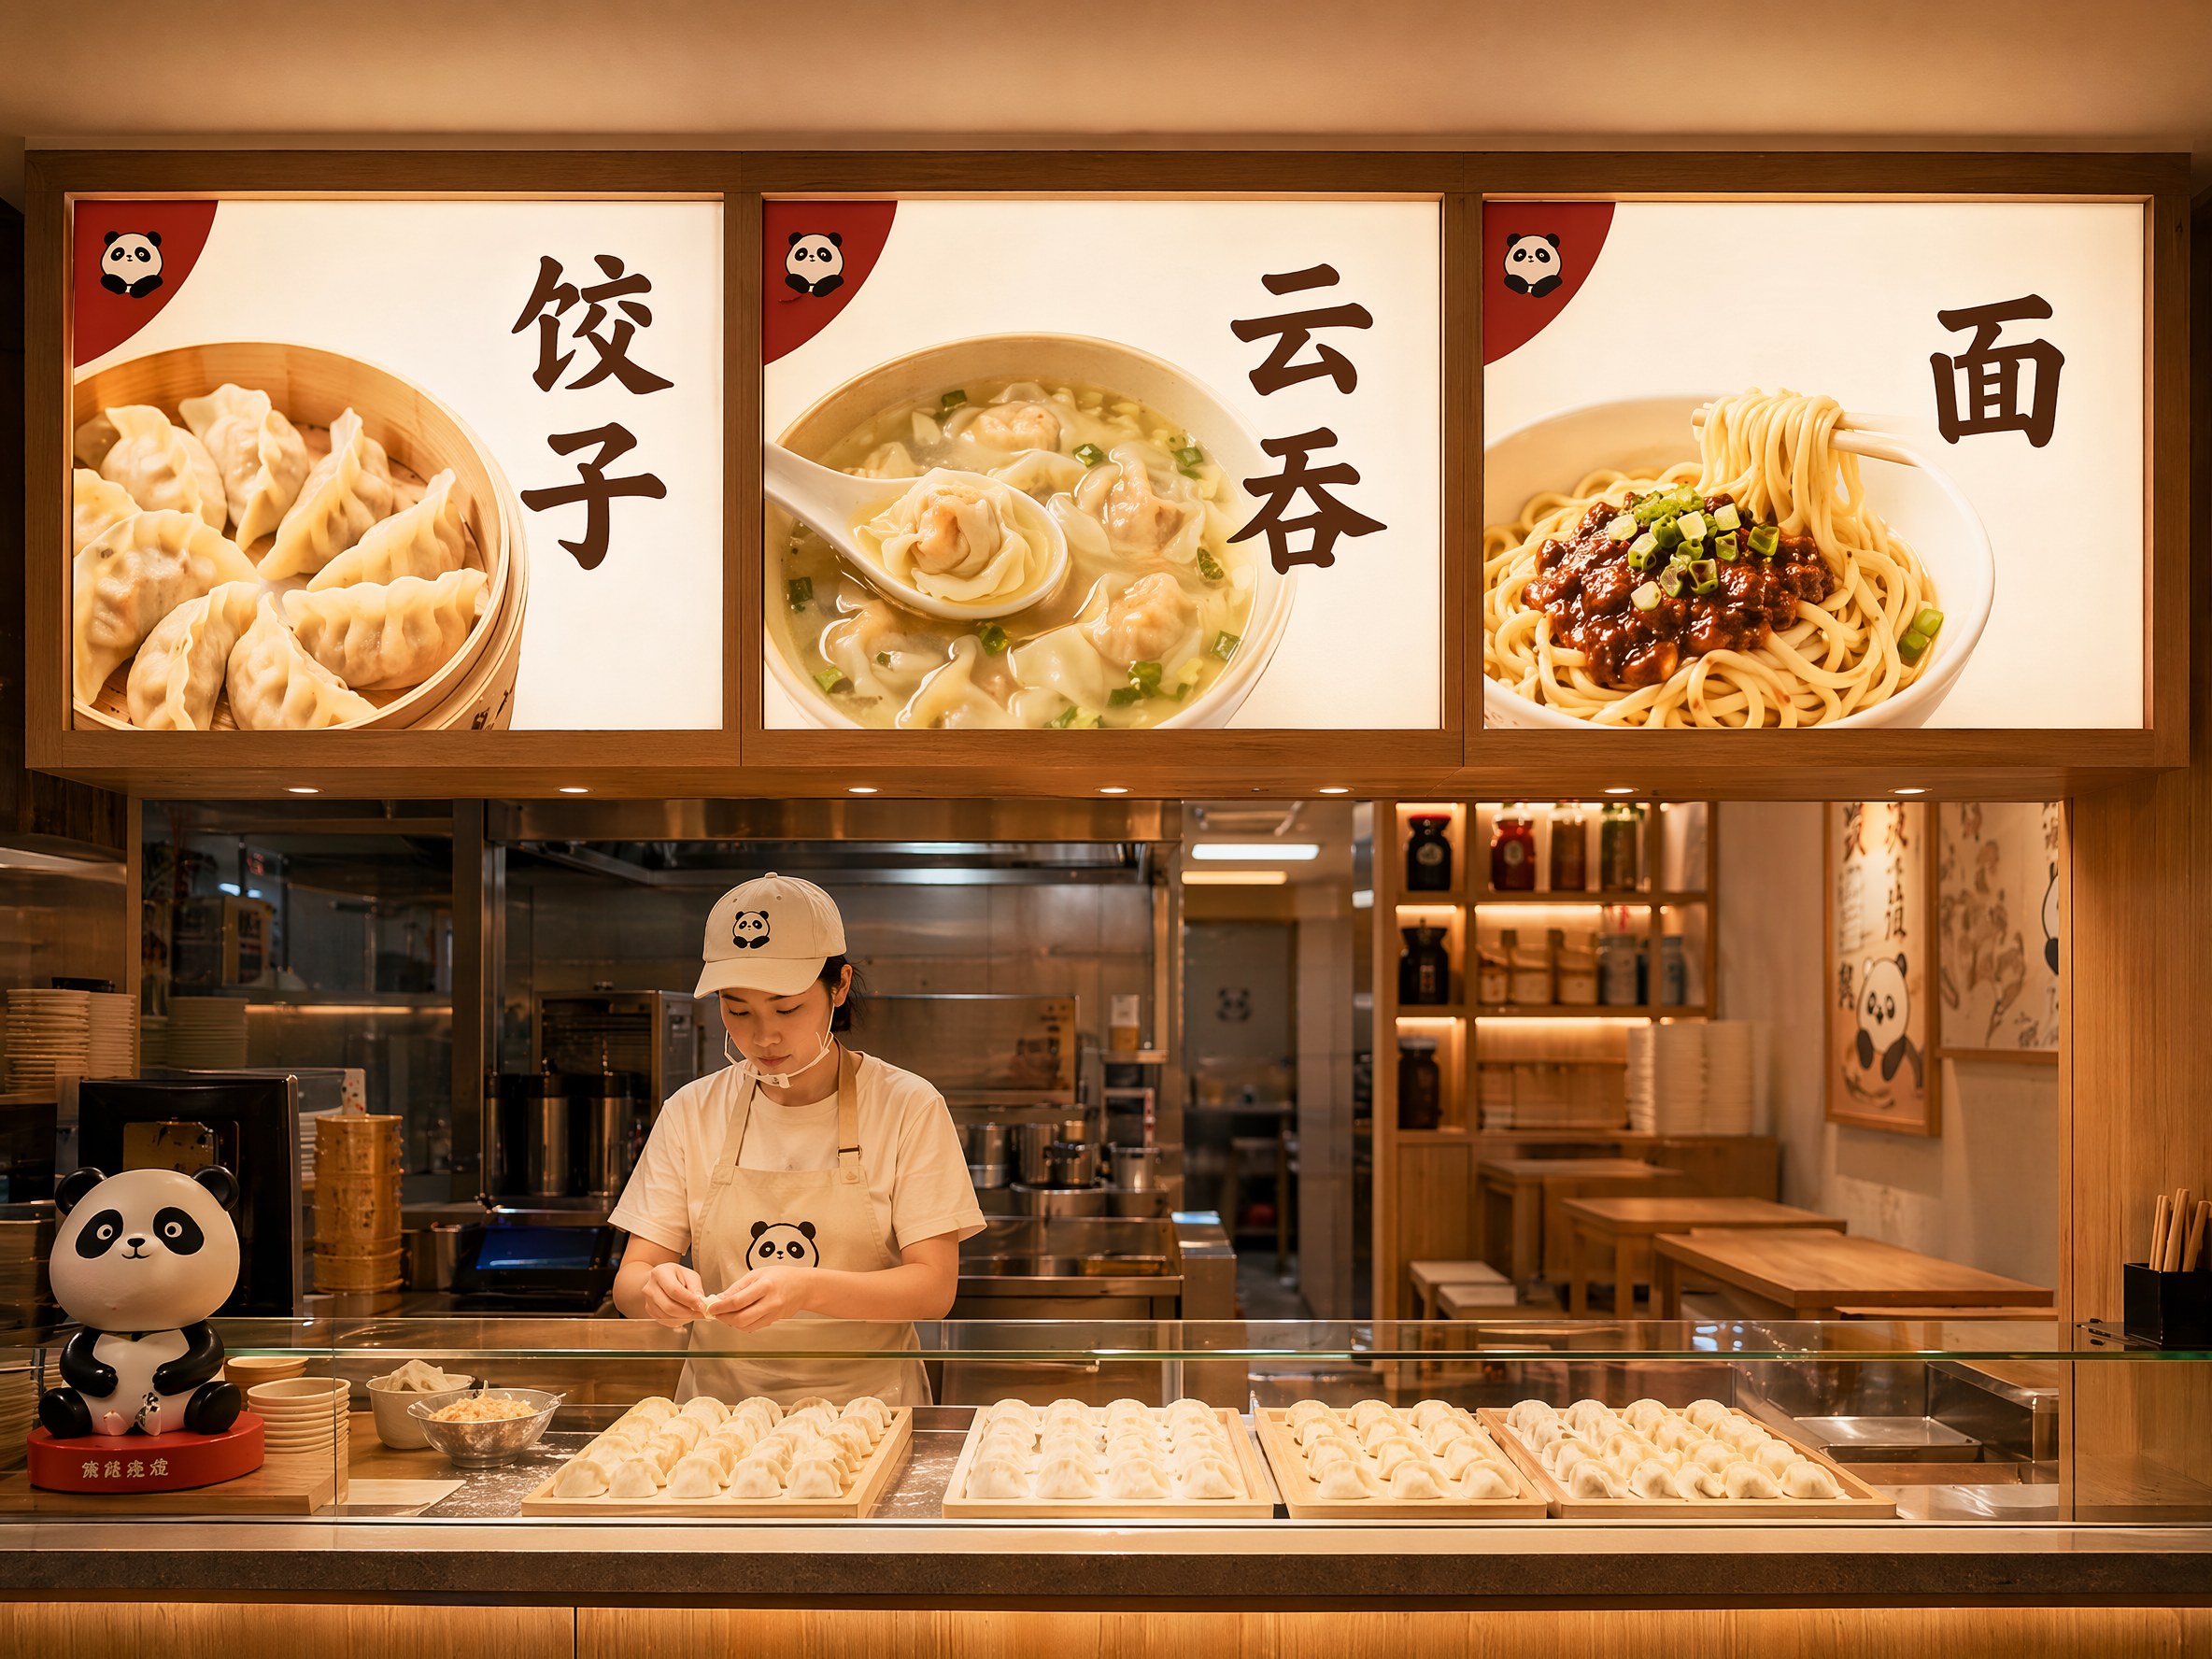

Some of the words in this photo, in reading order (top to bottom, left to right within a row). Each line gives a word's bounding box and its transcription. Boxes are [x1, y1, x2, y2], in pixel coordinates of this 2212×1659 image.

[511, 254, 674, 571] 饺子
[1226, 262, 1388, 575] 云吞
[1929, 293, 2065, 448] 面
